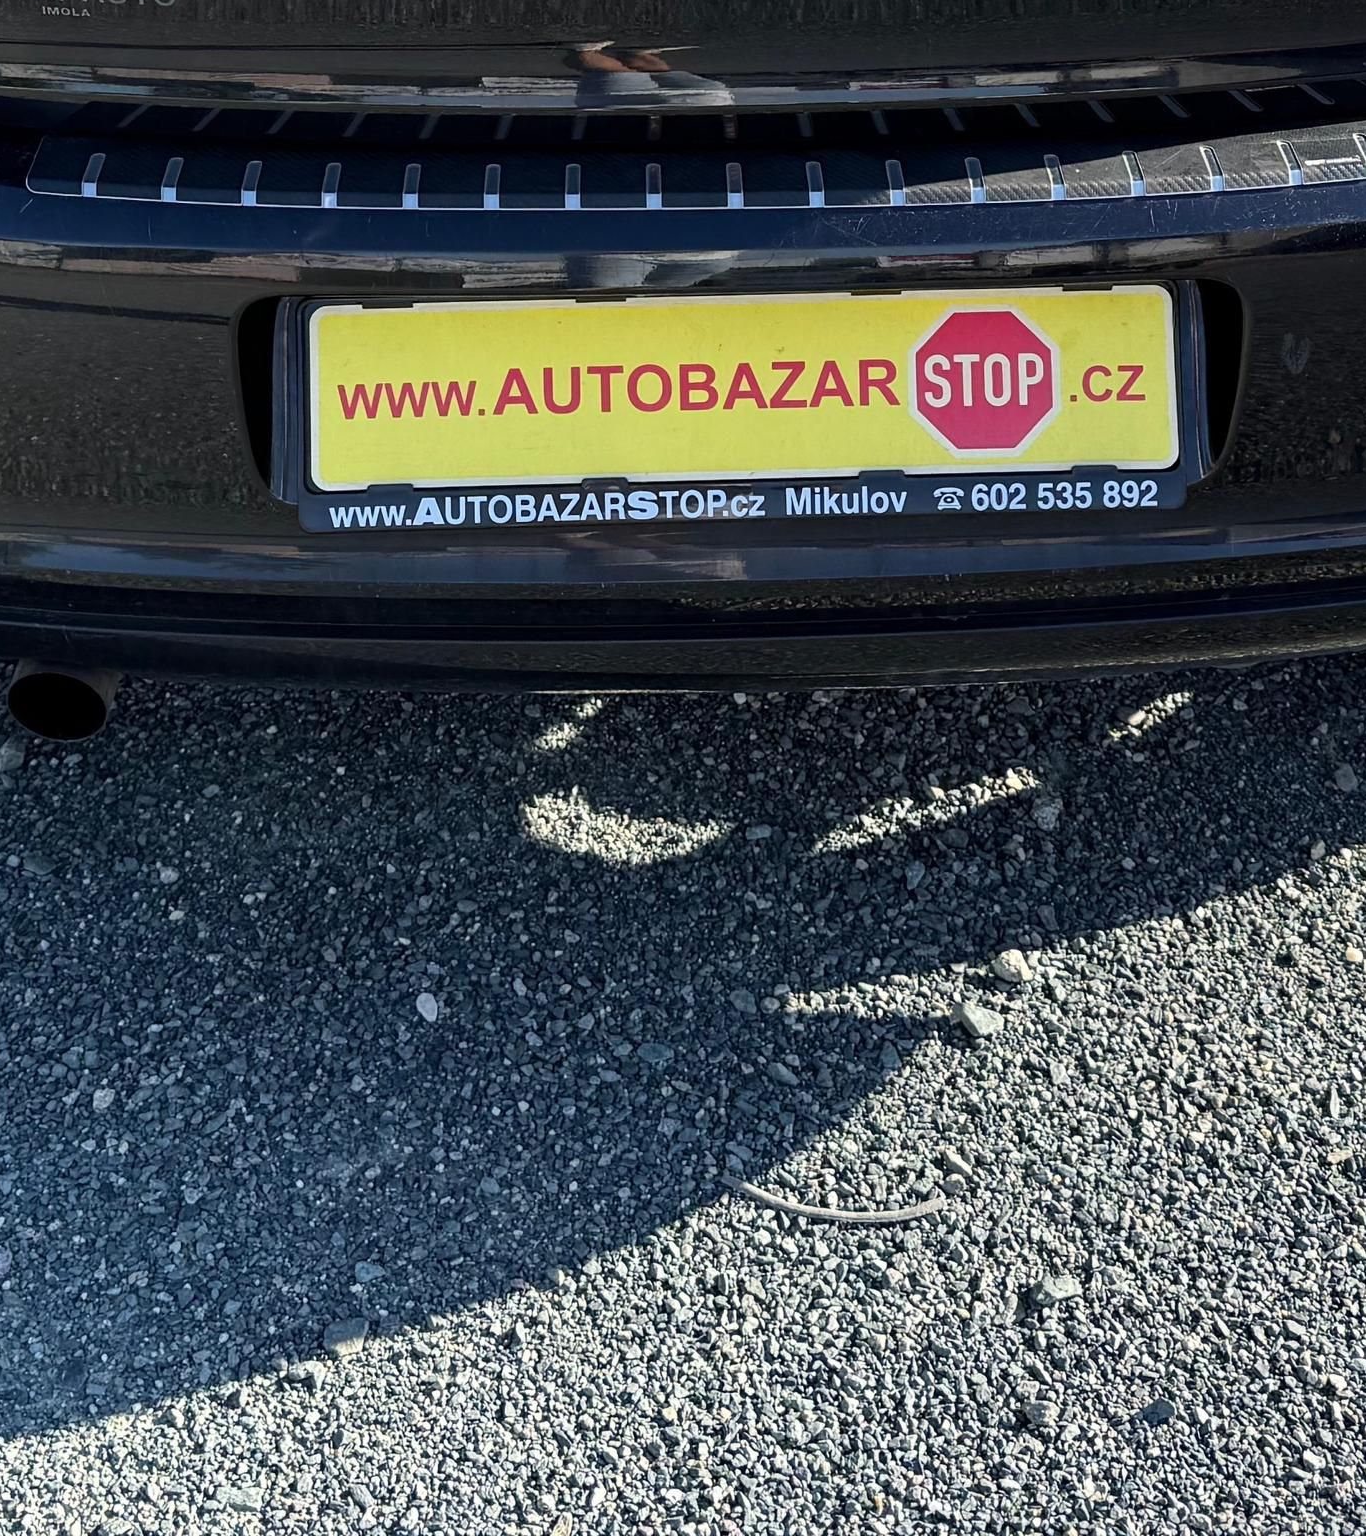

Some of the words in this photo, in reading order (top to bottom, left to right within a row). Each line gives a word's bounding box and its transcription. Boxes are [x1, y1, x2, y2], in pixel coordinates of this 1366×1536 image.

[41, 5, 91, 17] IMOLA
[924, 352, 1044, 408] STOP
[785, 485, 908, 515] Mikulov
[971, 482, 1027, 511] 602
[1037, 481, 1092, 509] 535
[1103, 479, 1159, 508] 892
